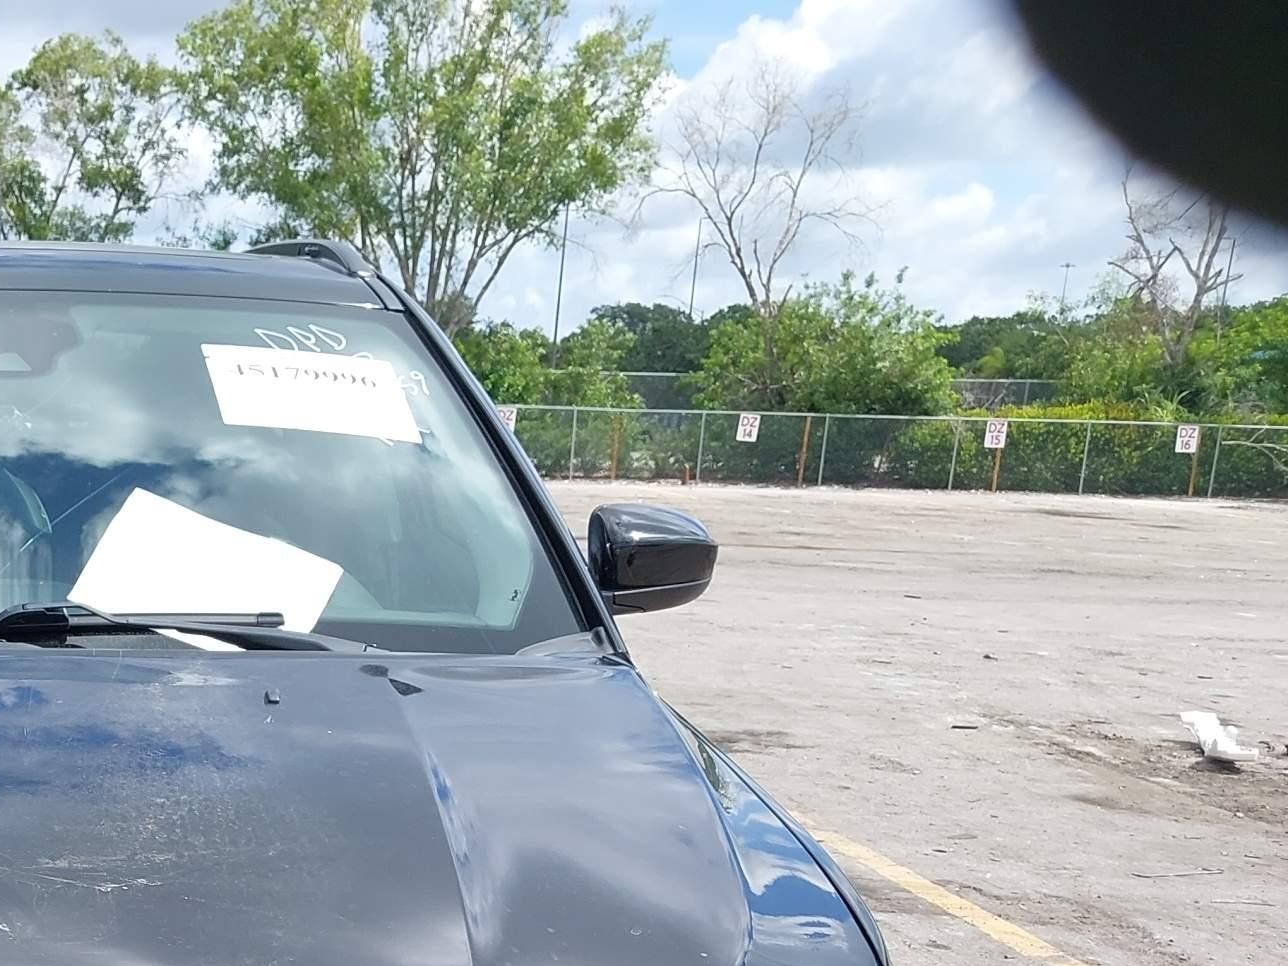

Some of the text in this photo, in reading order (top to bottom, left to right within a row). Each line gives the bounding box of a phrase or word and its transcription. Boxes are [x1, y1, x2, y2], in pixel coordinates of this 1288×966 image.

[741, 415, 758, 428] DZ
[989, 422, 1005, 433] DZ
[1179, 427, 1196, 438] DZ
[743, 428, 752, 439] 14
[990, 434, 1001, 445] 15
[1181, 439, 1191, 450] 16
